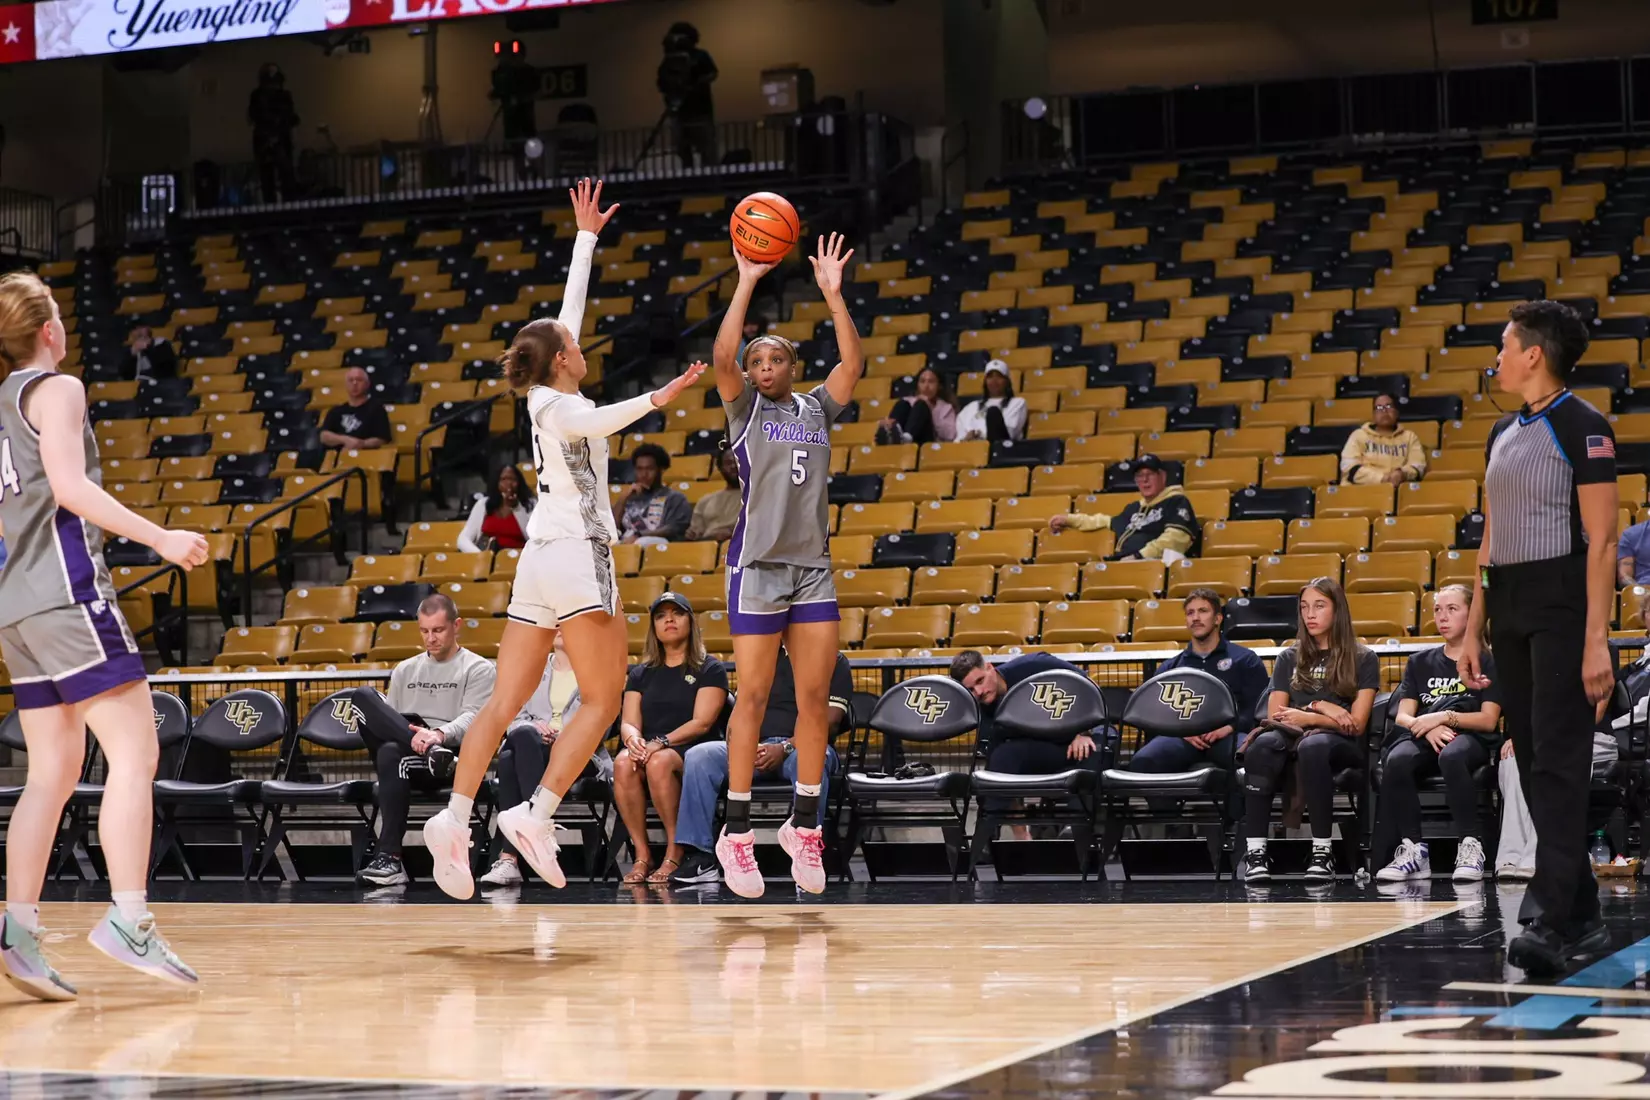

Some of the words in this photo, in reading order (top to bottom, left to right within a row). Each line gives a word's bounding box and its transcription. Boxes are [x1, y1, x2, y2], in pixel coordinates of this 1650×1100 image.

[540, 69, 577, 95] 06
[735, 223, 770, 249] ELITE
[0, 436, 22, 504] 4
[791, 448, 808, 486] 5
[407, 681, 459, 690] GREATER
[1029, 681, 1076, 720] UCF
[1157, 681, 1205, 720] UCF
[225, 699, 263, 735] UCF
[904, 686, 950, 725] UCF
